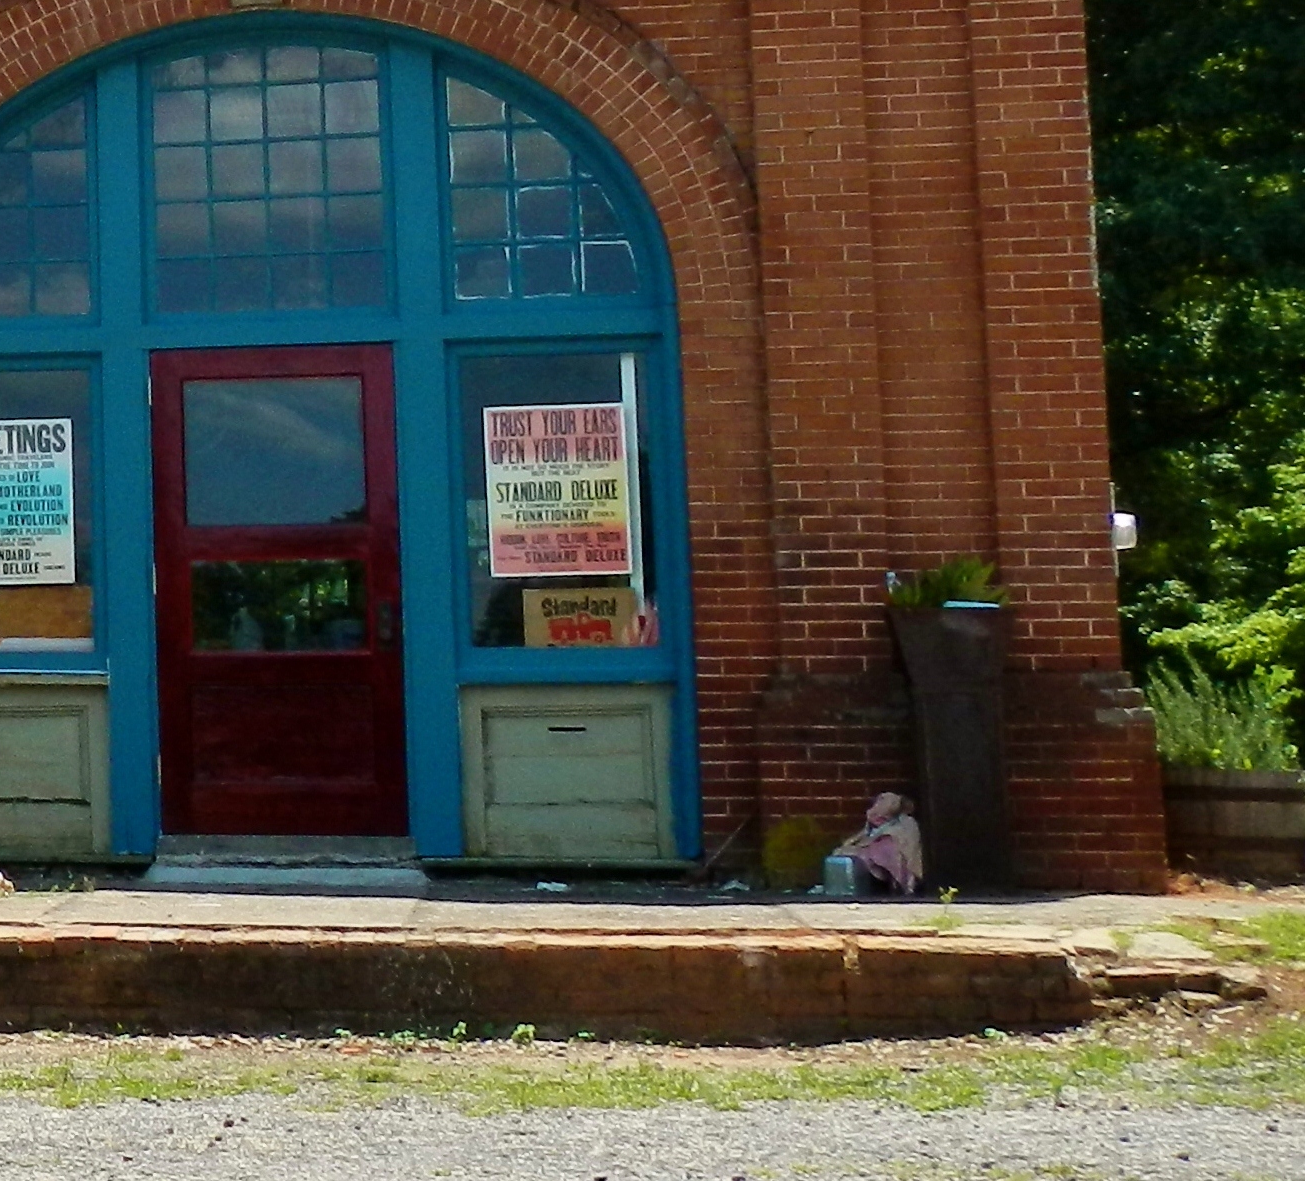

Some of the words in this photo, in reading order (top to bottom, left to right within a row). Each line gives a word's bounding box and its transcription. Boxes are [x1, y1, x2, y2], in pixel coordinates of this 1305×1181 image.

[491, 412, 533, 437] TRUST
[541, 410, 576, 436] YOUR
[584, 409, 618, 434] EARS
[490, 440, 525, 464] OPEN
[533, 438, 568, 463] YOUR
[576, 437, 618, 461] HEART
[17, 471, 40, 483] LOVE
[496, 481, 562, 503] STANDARD
[571, 479, 618, 500] DELUXE
[11, 500, 64, 511] EVOLUTION
[8, 514, 68, 526] REVOLUTION
[516, 509, 589, 521] FUNKTIONARY
[524, 550, 577, 563] STANDARD
[586, 549, 626, 562] DELUXE
[2, 562, 40, 575] DELUXE
[541, 596, 616, 617] Standard
